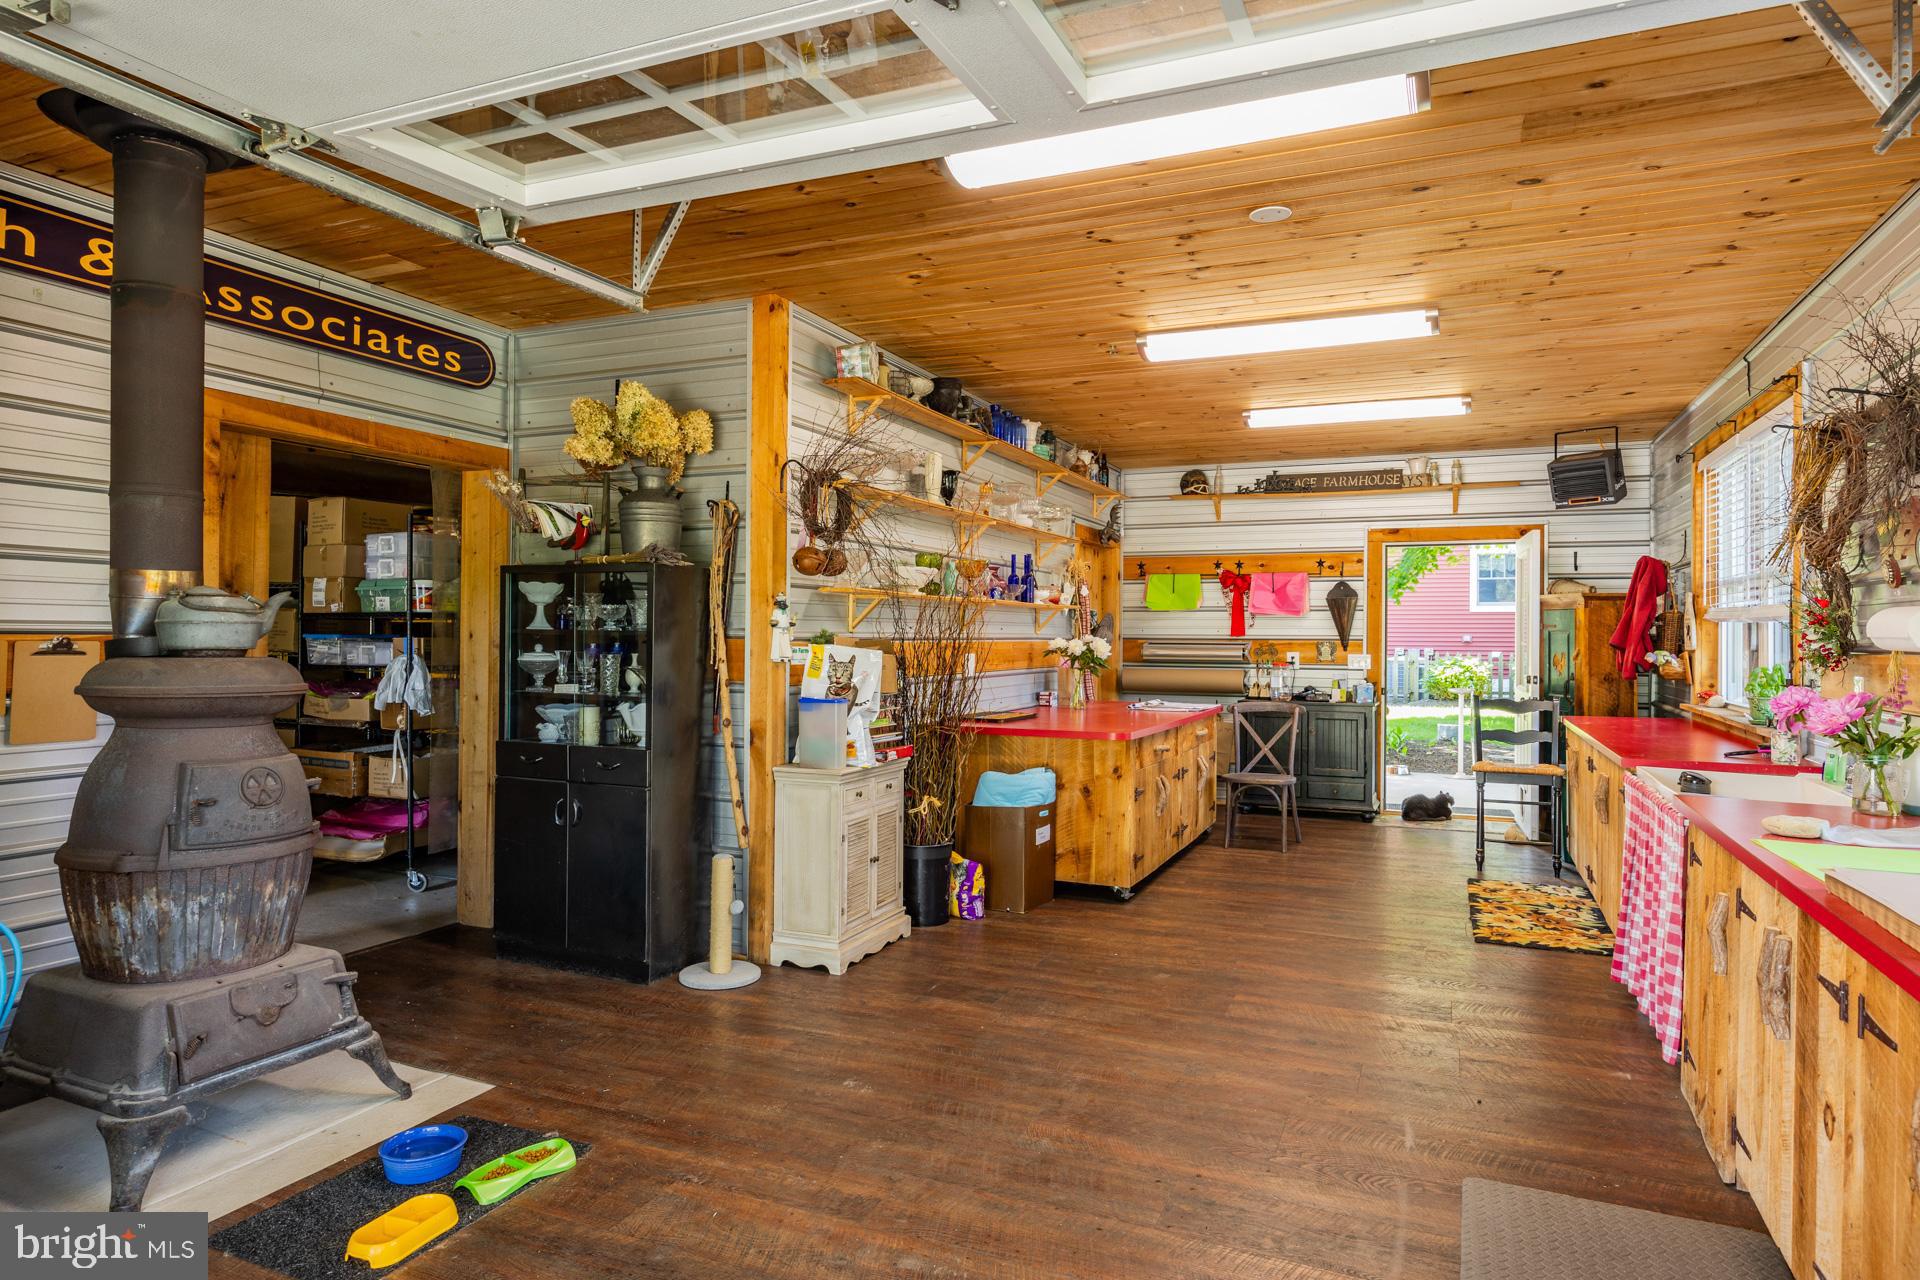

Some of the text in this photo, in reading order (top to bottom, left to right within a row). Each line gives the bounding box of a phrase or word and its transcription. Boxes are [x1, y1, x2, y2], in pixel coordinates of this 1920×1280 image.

[80, 238, 113, 276] &
[203, 286, 462, 373] ssociates
[1323, 473, 1401, 488] FARMHOUSE
